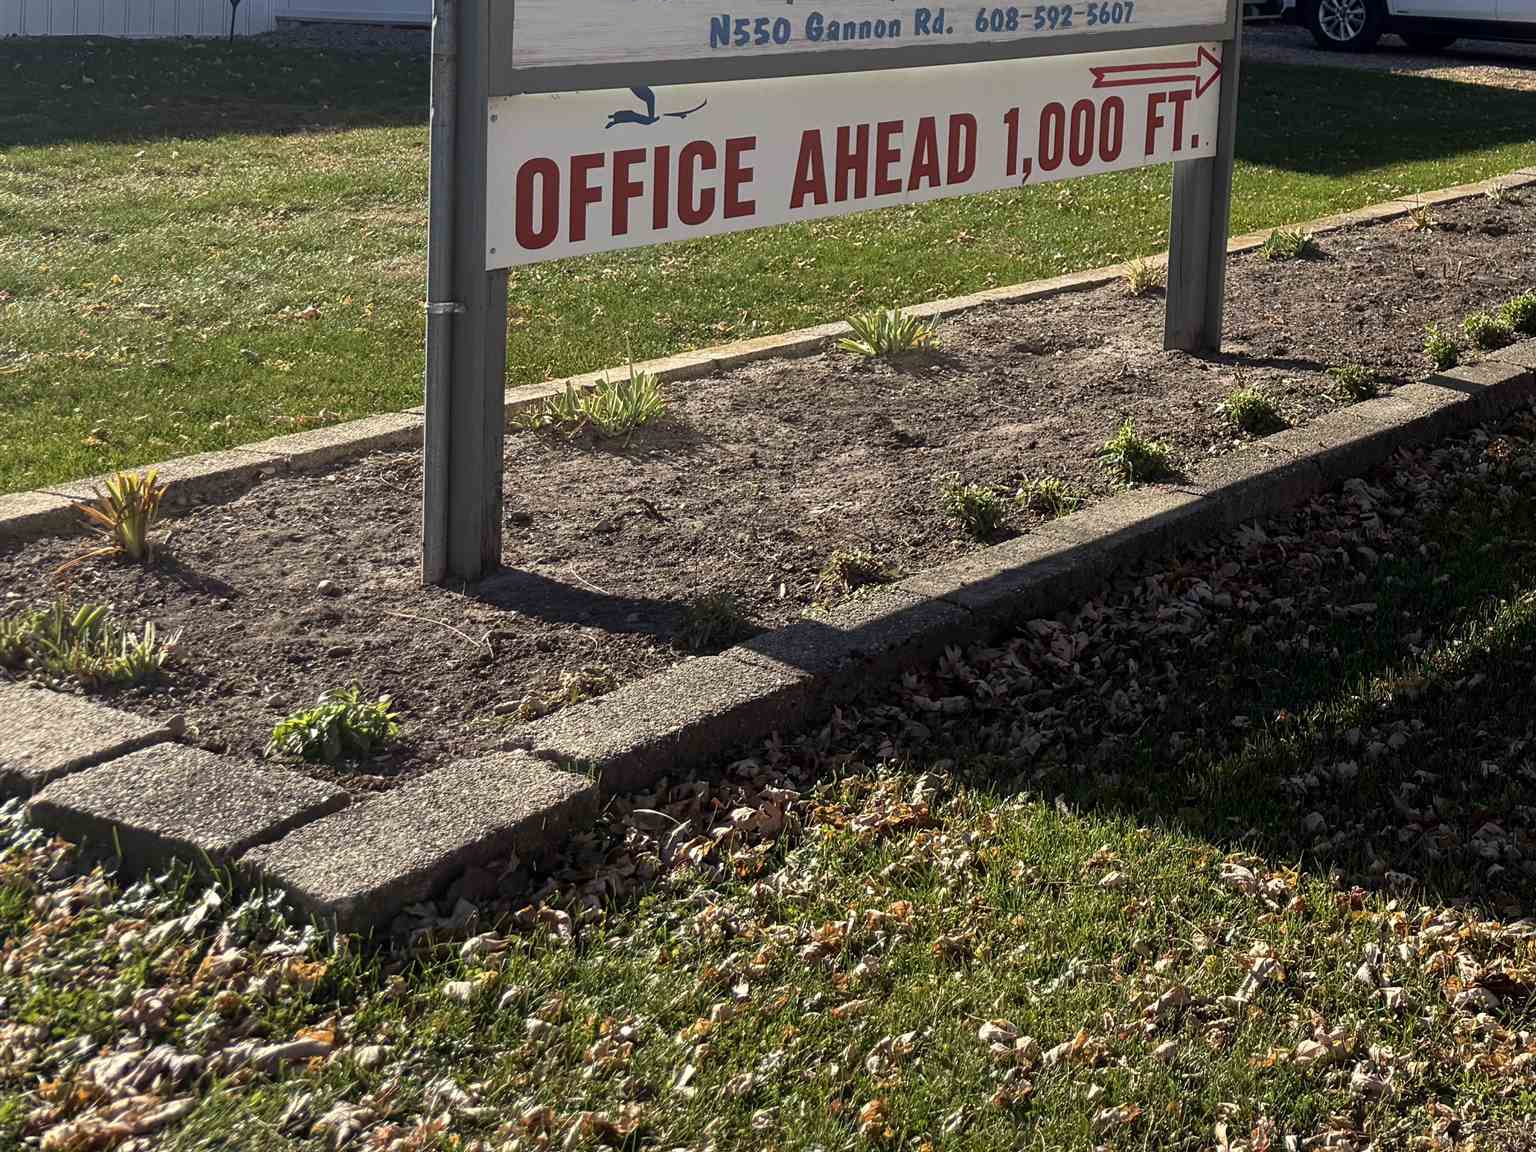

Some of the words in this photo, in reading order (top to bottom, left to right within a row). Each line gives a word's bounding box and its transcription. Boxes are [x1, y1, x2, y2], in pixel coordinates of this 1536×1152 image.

[709, 13, 792, 48] N550
[805, 11, 901, 41] Gannon
[914, 7, 953, 36] Rd.
[975, 1, 1135, 33] 608-592-5607
[514, 136, 757, 250] OFFICE
[788, 111, 978, 210] AHEAD
[1003, 94, 1125, 187] 1,000
[1144, 89, 1199, 156] FT.
